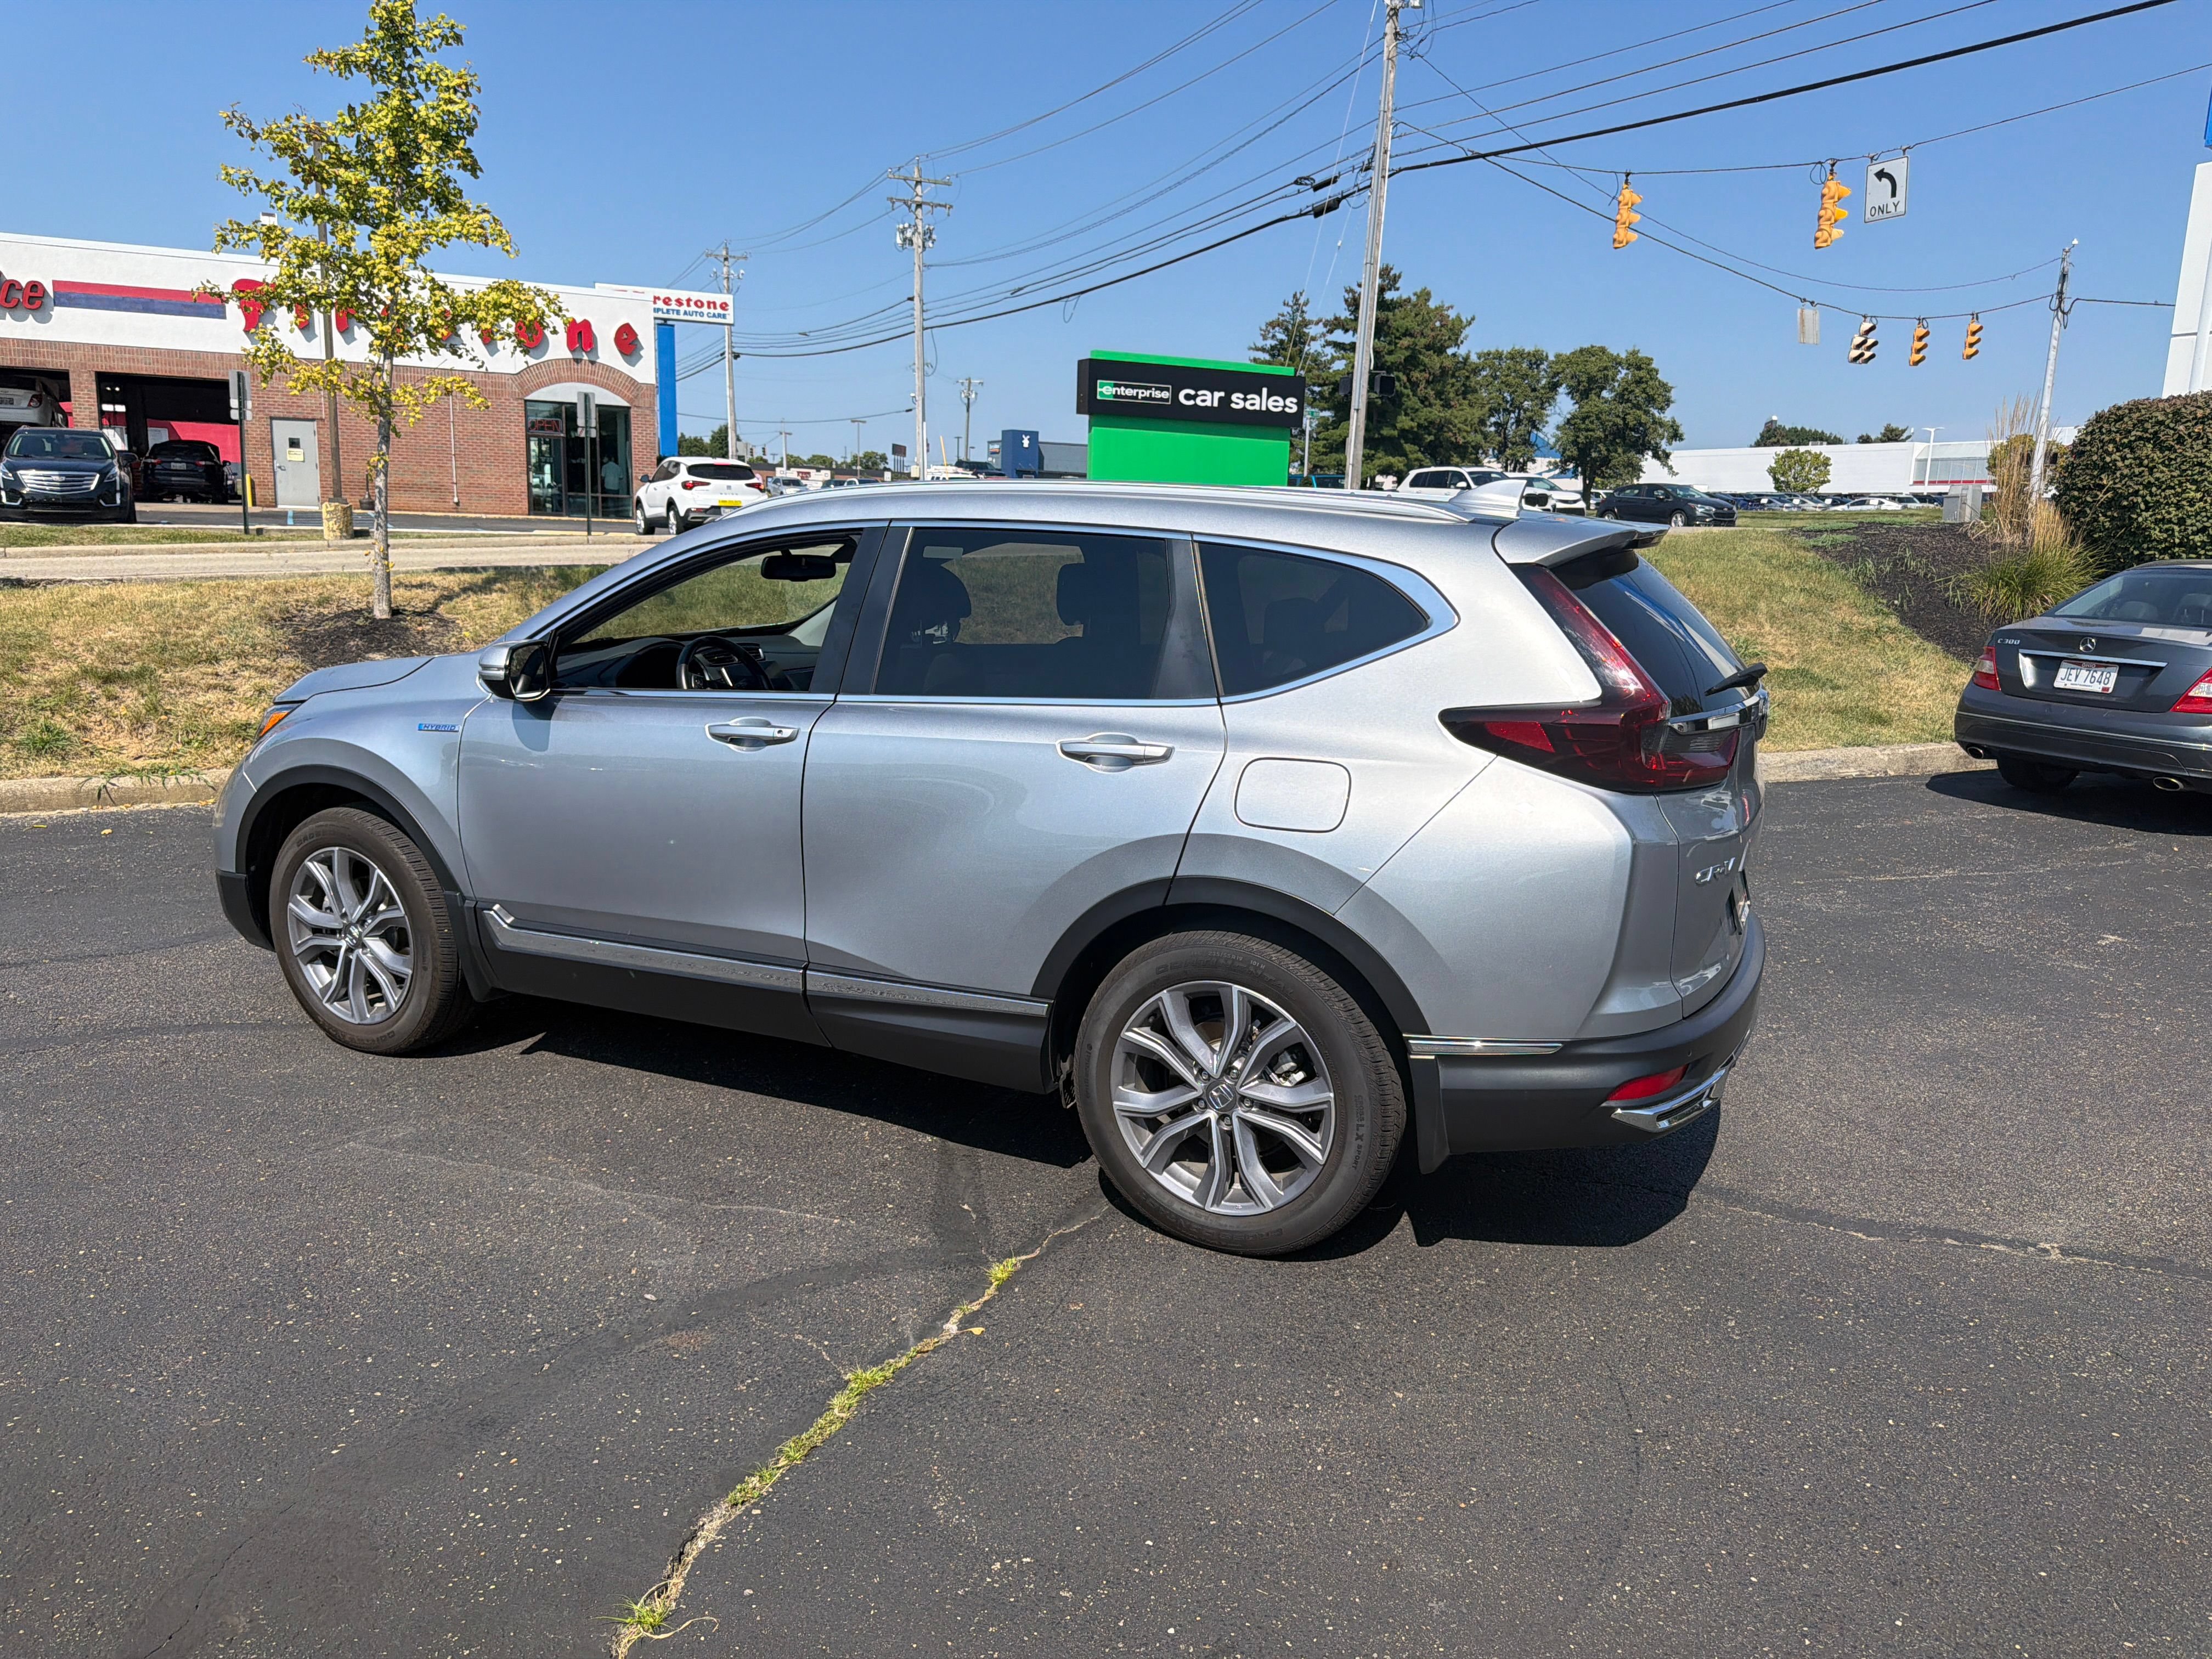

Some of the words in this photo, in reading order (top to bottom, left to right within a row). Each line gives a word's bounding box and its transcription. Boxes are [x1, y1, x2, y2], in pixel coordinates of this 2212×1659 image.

[1870, 201, 1900, 217] ONLY
[1101, 385, 1170, 399] enterprise
[1178, 388, 1225, 407] car
[1230, 387, 1298, 413] sales
[528, 419, 560, 432] OPEN
[2061, 667, 2081, 682] JEV
[2084, 669, 2112, 685] 7648
